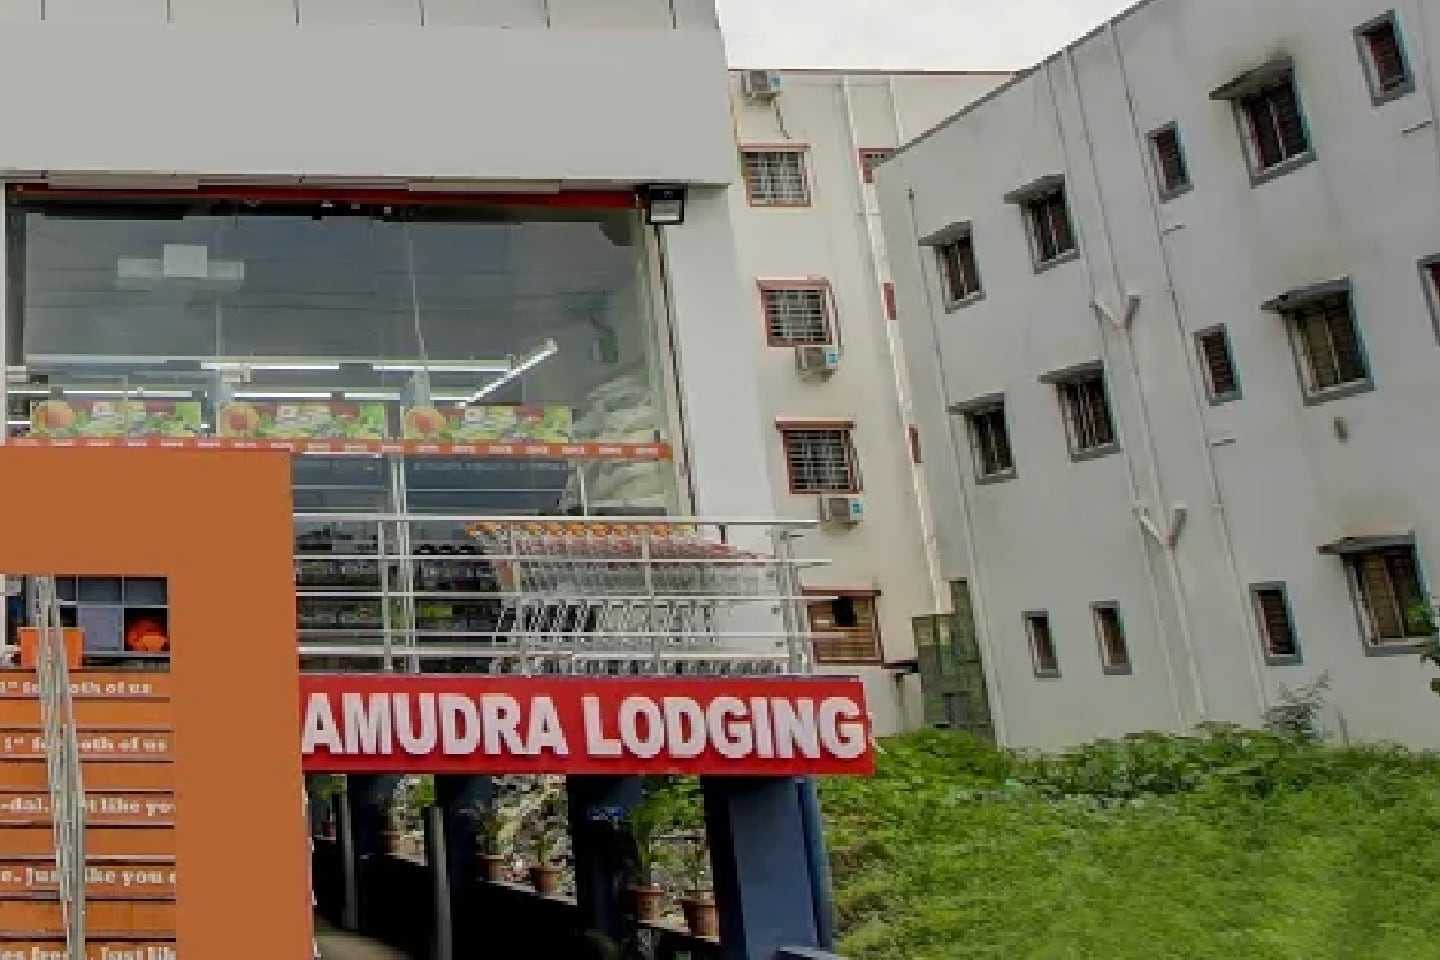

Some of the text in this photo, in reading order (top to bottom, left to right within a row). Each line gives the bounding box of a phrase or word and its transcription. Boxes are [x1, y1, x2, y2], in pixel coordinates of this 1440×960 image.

[70, 682, 101, 695] oth
[581, 695, 864, 759] LODGING
[101, 798, 140, 813] like
[122, 870, 163, 887] you
